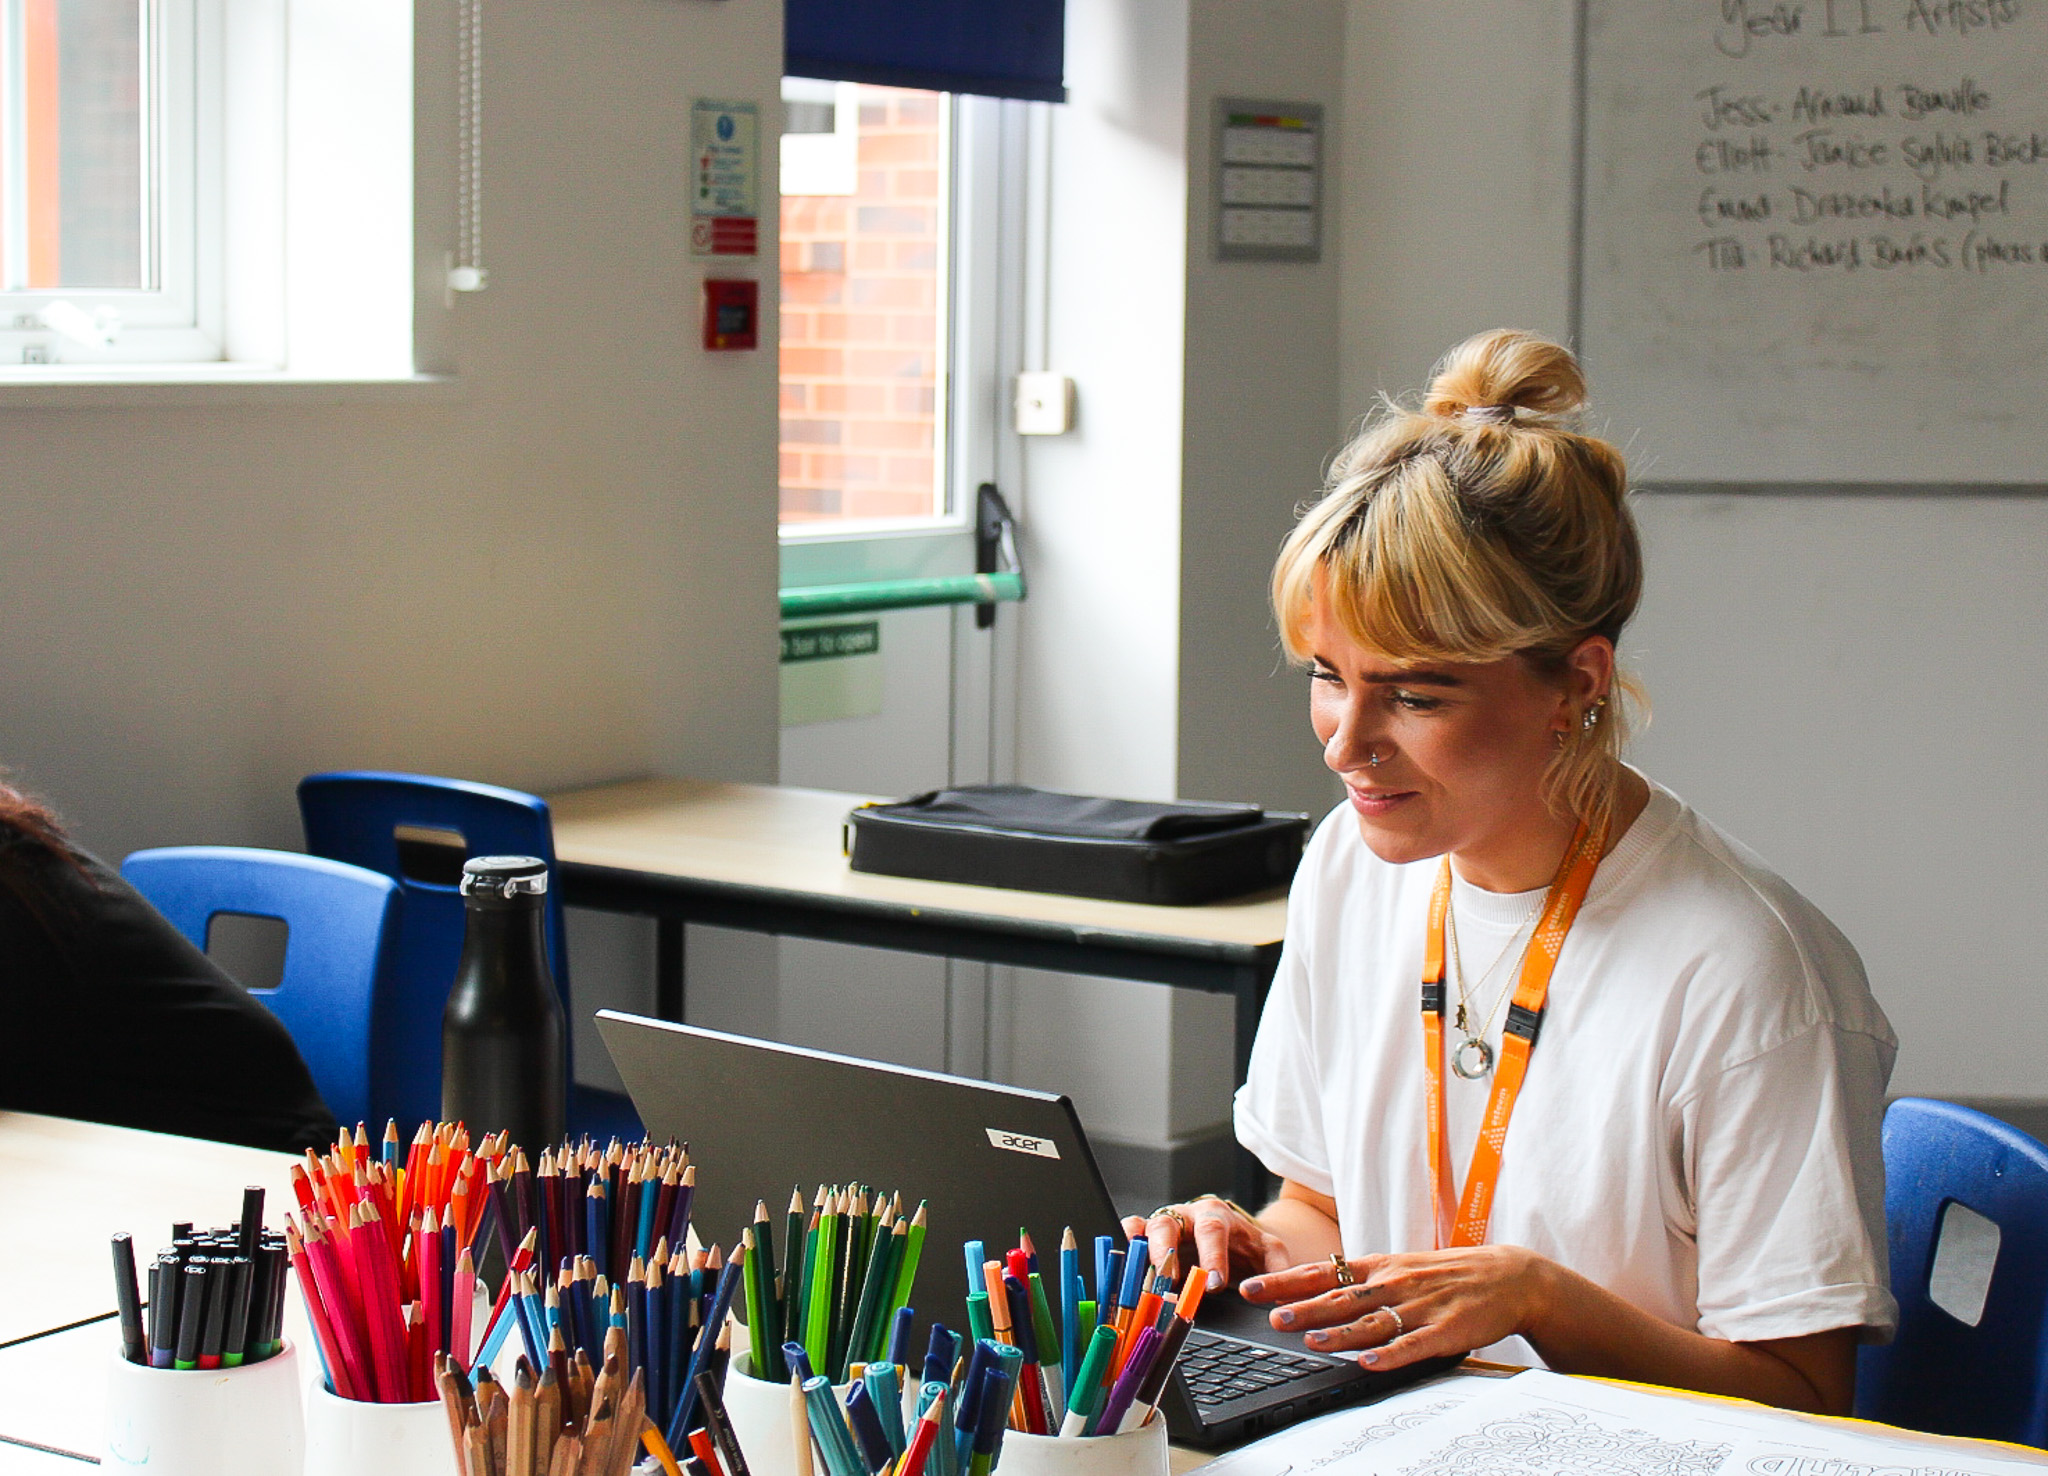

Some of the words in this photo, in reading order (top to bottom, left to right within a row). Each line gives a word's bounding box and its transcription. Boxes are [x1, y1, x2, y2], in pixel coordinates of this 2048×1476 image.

[1491, 1088, 1507, 1126] esteem
[1002, 1135, 1042, 1151] acer
[1468, 1182, 1484, 1219] esteem
